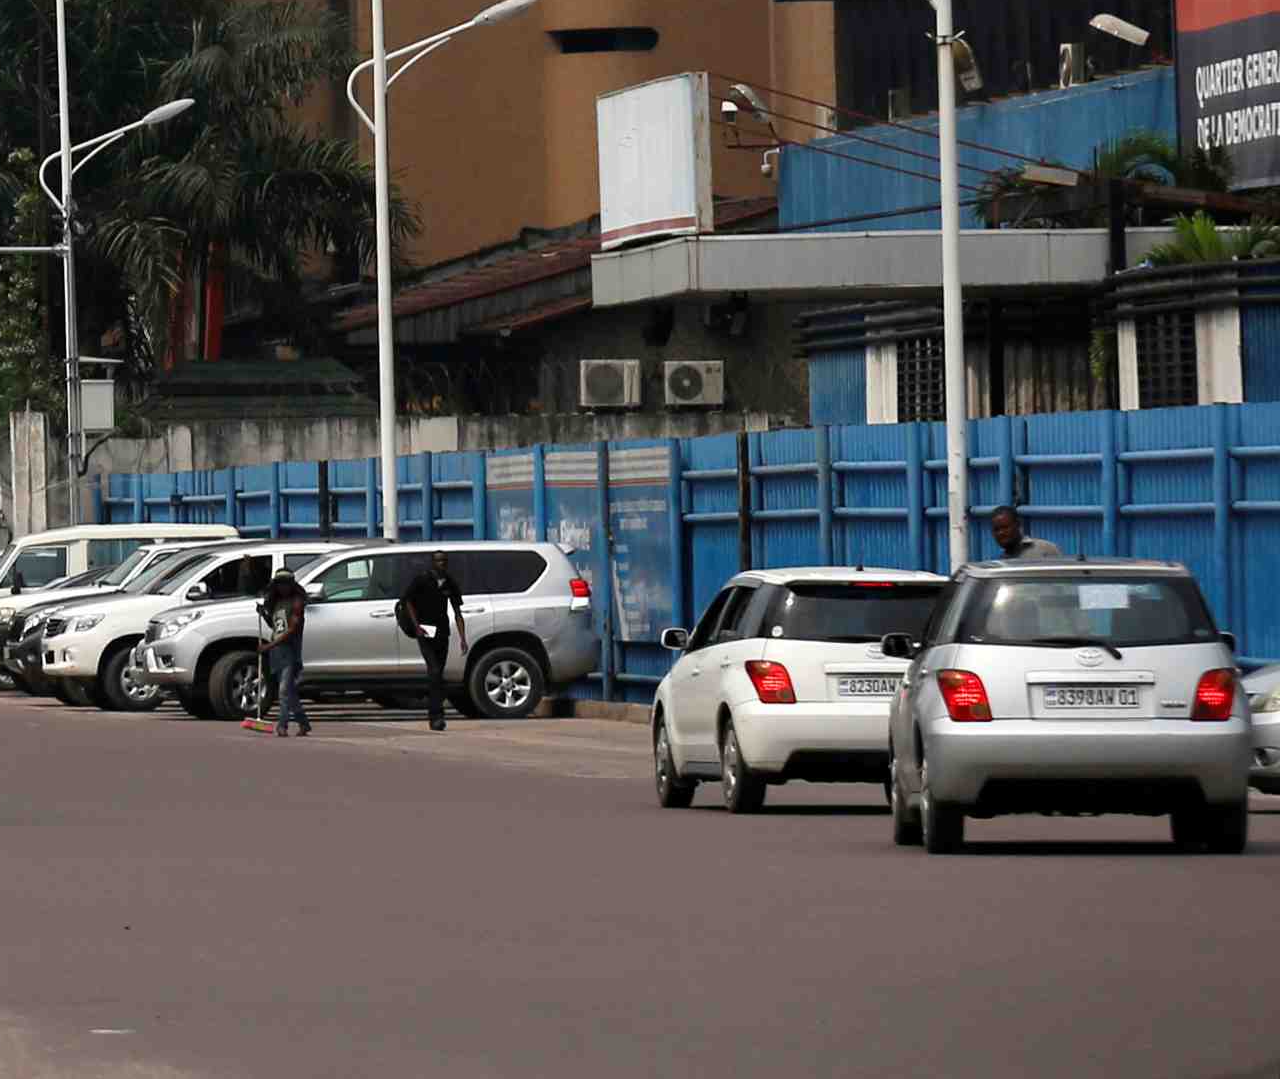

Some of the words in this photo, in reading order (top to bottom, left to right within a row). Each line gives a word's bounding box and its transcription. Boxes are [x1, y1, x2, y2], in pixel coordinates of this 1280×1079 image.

[1196, 58, 1245, 109] QUARTIER
[1246, 50, 1280, 89] GENER
[1197, 117, 1210, 151] DE
